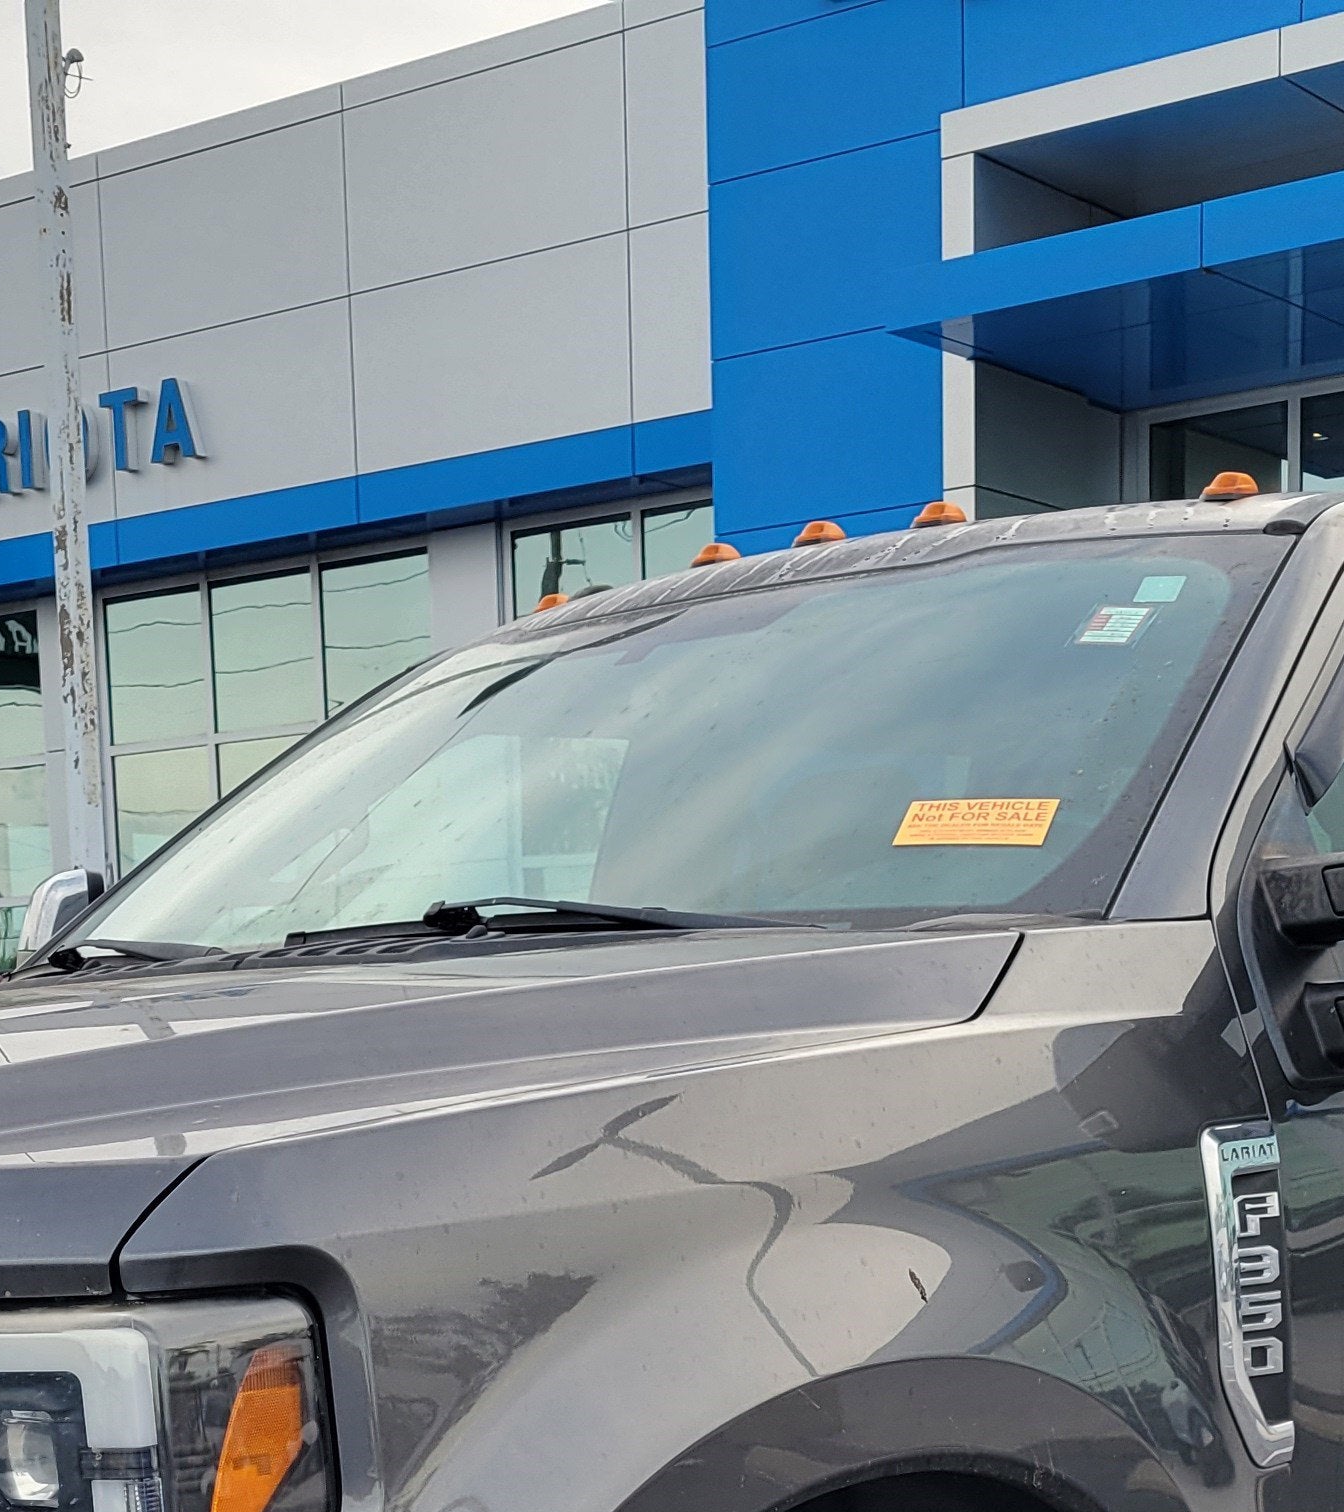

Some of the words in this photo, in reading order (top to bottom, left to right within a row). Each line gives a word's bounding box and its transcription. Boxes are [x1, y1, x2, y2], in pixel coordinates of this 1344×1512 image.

[917, 802, 958, 812] THIS
[967, 801, 1051, 811] VEHICLE
[912, 813, 943, 822] Not
[949, 812, 990, 821] FOR
[995, 812, 1048, 822] SALE
[1221, 1142, 1275, 1161] LARIAT
